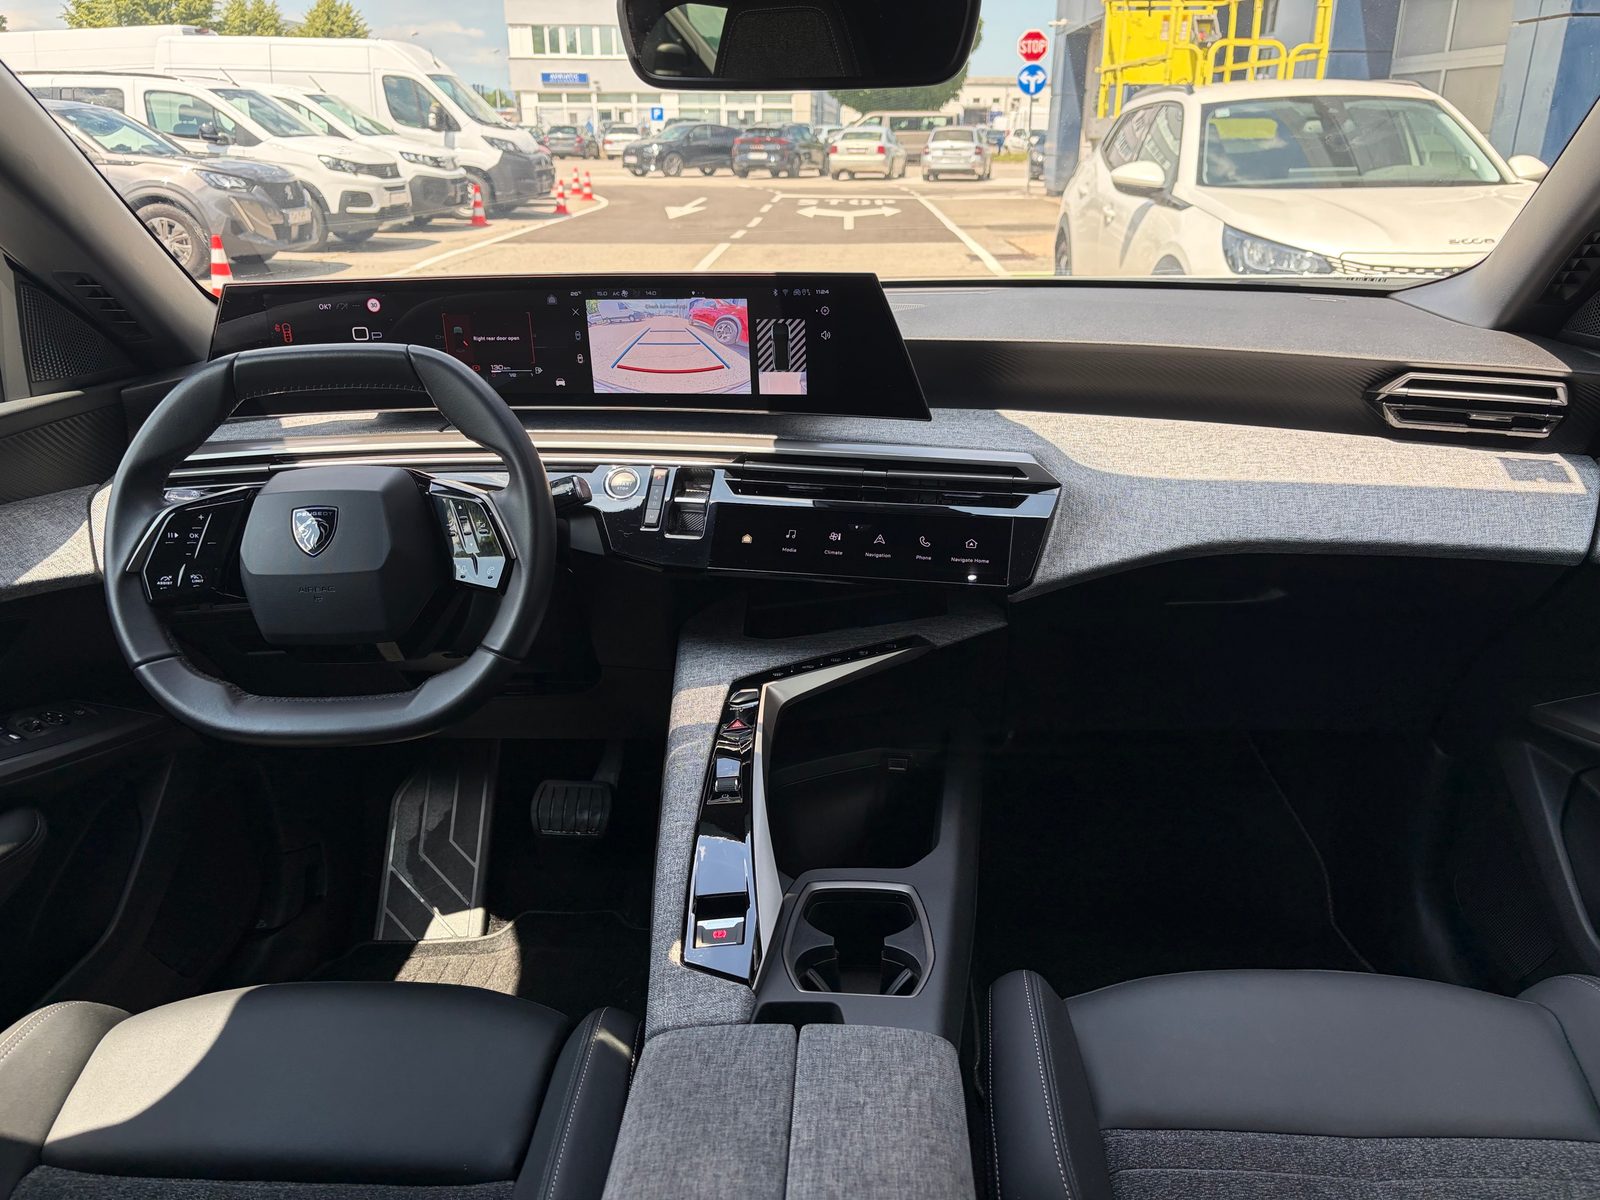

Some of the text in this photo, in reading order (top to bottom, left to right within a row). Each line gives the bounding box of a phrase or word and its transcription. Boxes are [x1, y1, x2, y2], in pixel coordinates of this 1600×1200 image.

[1020, 39, 1047, 54] STOP
[797, 198, 897, 206] STOP
[298, 585, 336, 593] AIRBAG
